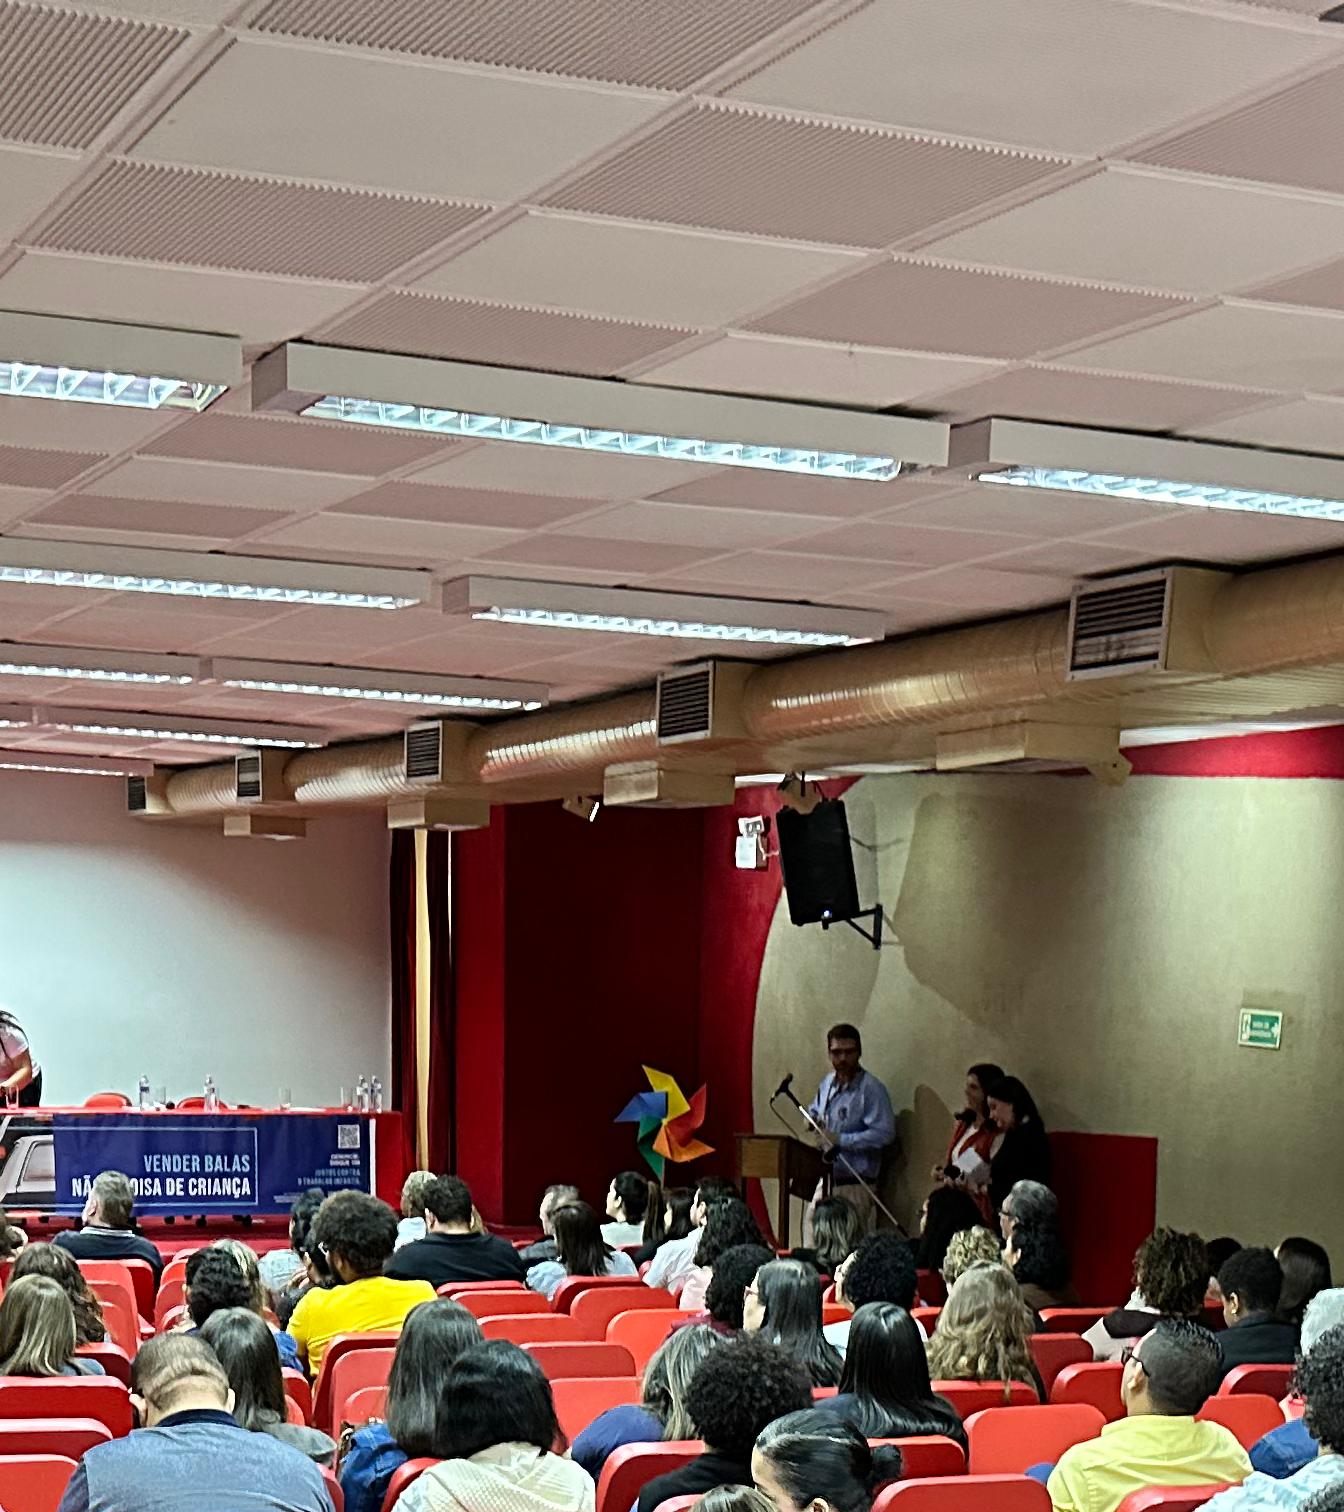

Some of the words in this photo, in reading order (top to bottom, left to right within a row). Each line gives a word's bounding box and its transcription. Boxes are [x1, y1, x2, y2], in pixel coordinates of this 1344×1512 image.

[144, 1154, 200, 1172] VENDER
[205, 1154, 251, 1172] BALAS
[72, 1175, 92, 1197] NÃ
[131, 1178, 162, 1196] OISA
[166, 1178, 184, 1196] DE
[188, 1177, 251, 1198] CRIANÇA
